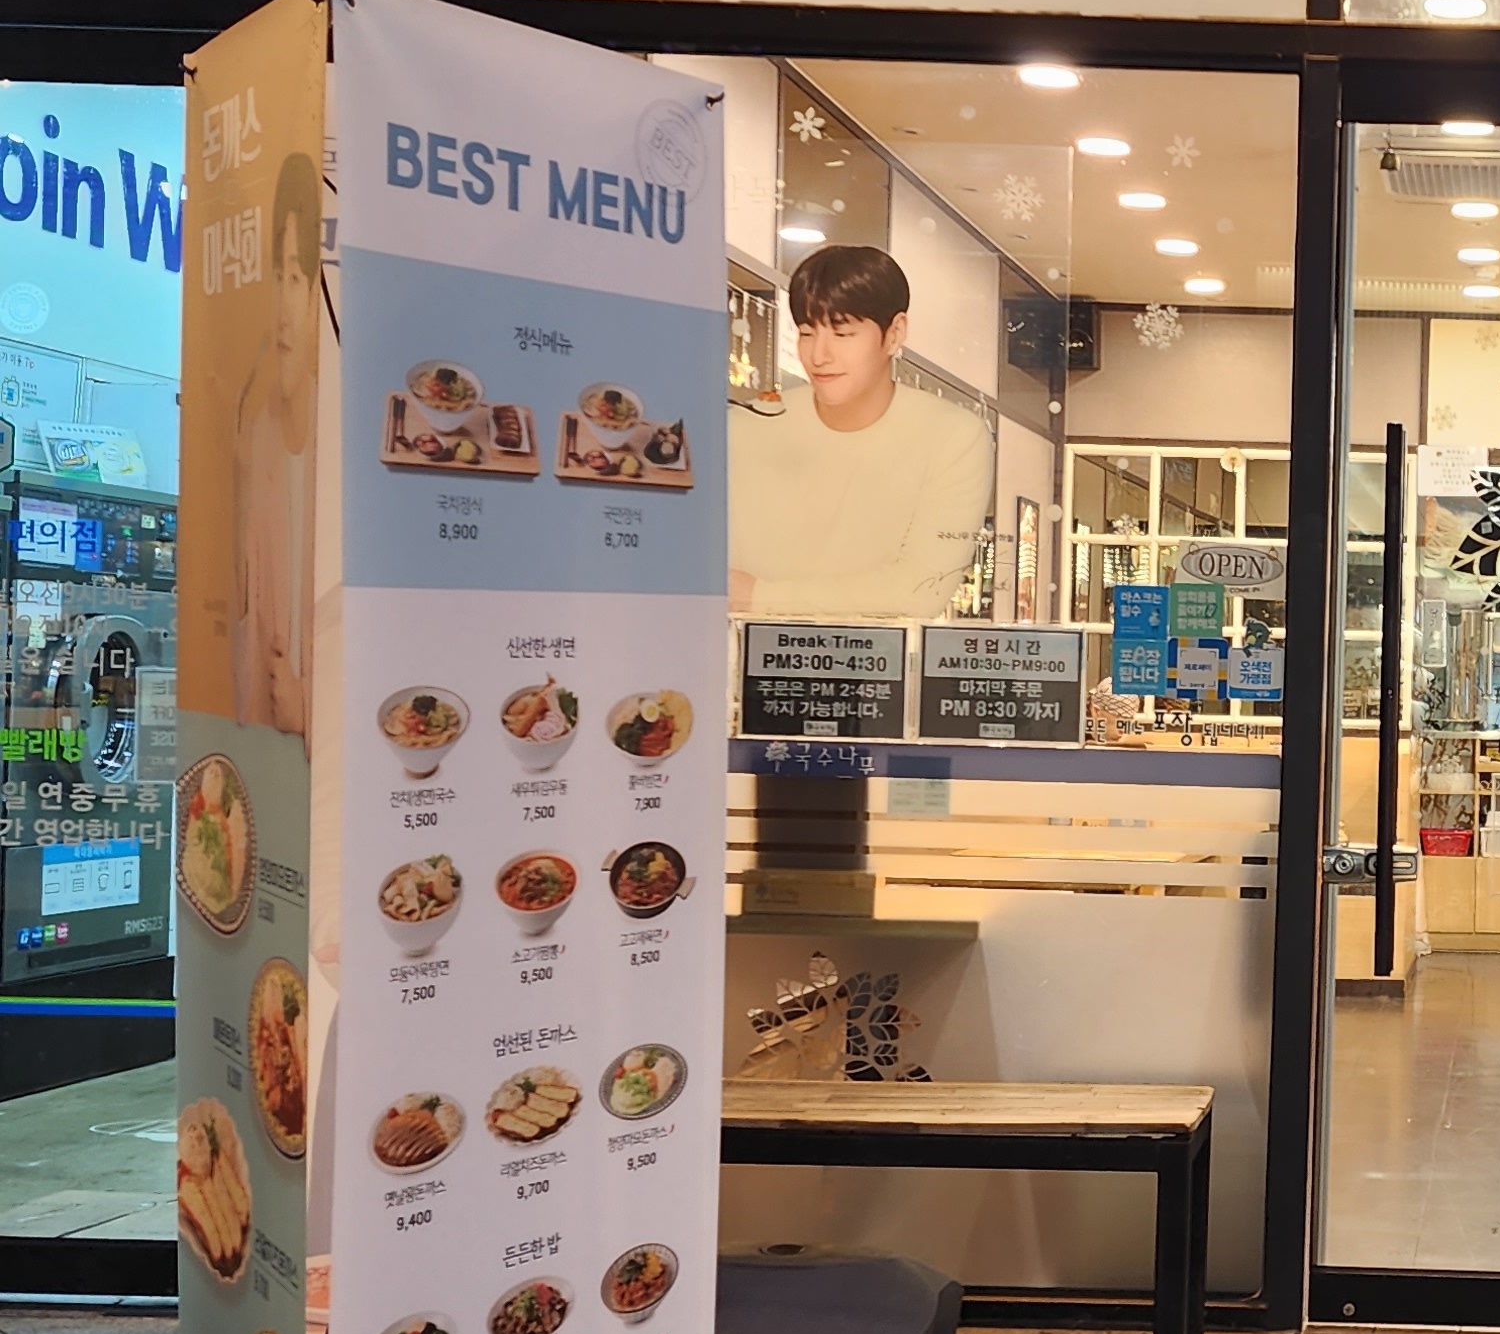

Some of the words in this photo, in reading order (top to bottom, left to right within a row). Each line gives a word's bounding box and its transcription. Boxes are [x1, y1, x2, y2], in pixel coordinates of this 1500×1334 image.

[201, 86, 263, 183] 돈까스
[648, 127, 698, 180] BEST
[386, 121, 531, 213] BEST
[548, 159, 686, 246] MENU
[202, 205, 263, 297] 미식회
[513, 325, 575, 357] 정식메뉴
[438, 522, 479, 542] 8,900
[1198, 552, 1266, 581] OPEN
[505, 636, 547, 660] 신선한
[777, 633, 828, 650] Break
[833, 635, 874, 650] Time
[963, 637, 1042, 656] 영업시간
[762, 653, 888, 672] PM3:00~4:30
[937, 656, 1066, 674] AM10:30~PM9:00
[756, 679, 805, 699] 주문은
[809, 682, 835, 698] PM
[838, 683, 892, 701] 2:45분
[958, 679, 1007, 698] 마지막
[1009, 681, 1044, 699] 주문
[763, 700, 795, 717] 까지
[798, 700, 885, 719] 가능합니다.
[939, 699, 970, 717] PM
[975, 700, 1018, 719] 8:30
[1022, 701, 1061, 723] 까지
[1085, 718, 1107, 744] 모든
[1116, 719, 1145, 736] 메뉴
[1153, 710, 1193, 747] 포장
[0, 727, 86, 763] 빨래방
[795, 742, 876, 776] 국수나무
[403, 811, 439, 831] 5,500
[522, 804, 556, 824] 7,500
[33, 818, 165, 851] 영업합니다
[520, 966, 554, 985] 9,500
[400, 984, 436, 1006] 7,500
[492, 1029, 533, 1058] 엄선된
[535, 1023, 579, 1050] 돈까스
[516, 1179, 551, 1201] 9,700
[395, 1209, 433, 1233] 9,400
[502, 1238, 545, 1269] 든든한
[546, 1231, 563, 1256] 밥
